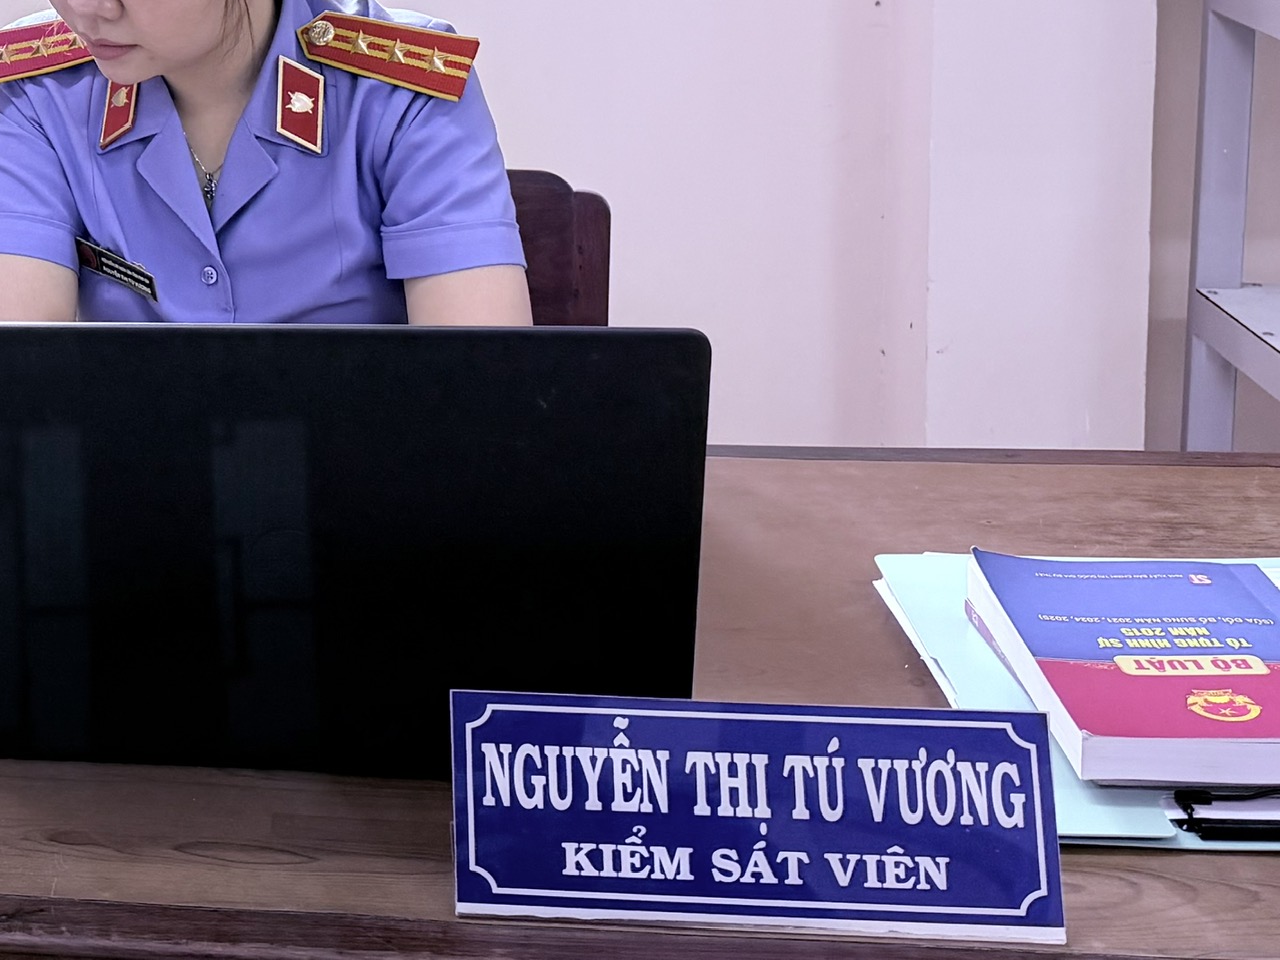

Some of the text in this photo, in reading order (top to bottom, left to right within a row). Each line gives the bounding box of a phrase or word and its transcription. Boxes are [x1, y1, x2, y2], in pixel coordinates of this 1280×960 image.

[1119, 626, 1211, 637] NĂM 2015
[1096, 636, 1253, 650] TỐ TỤNG HÌNH SỰ
[1134, 656, 1253, 673] BỘ LUẬT
[480, 716, 1026, 836] NGUYỄN THỊ TÚ VƯƠNG
[561, 825, 950, 891] KIỂM SÁT VIÊN
